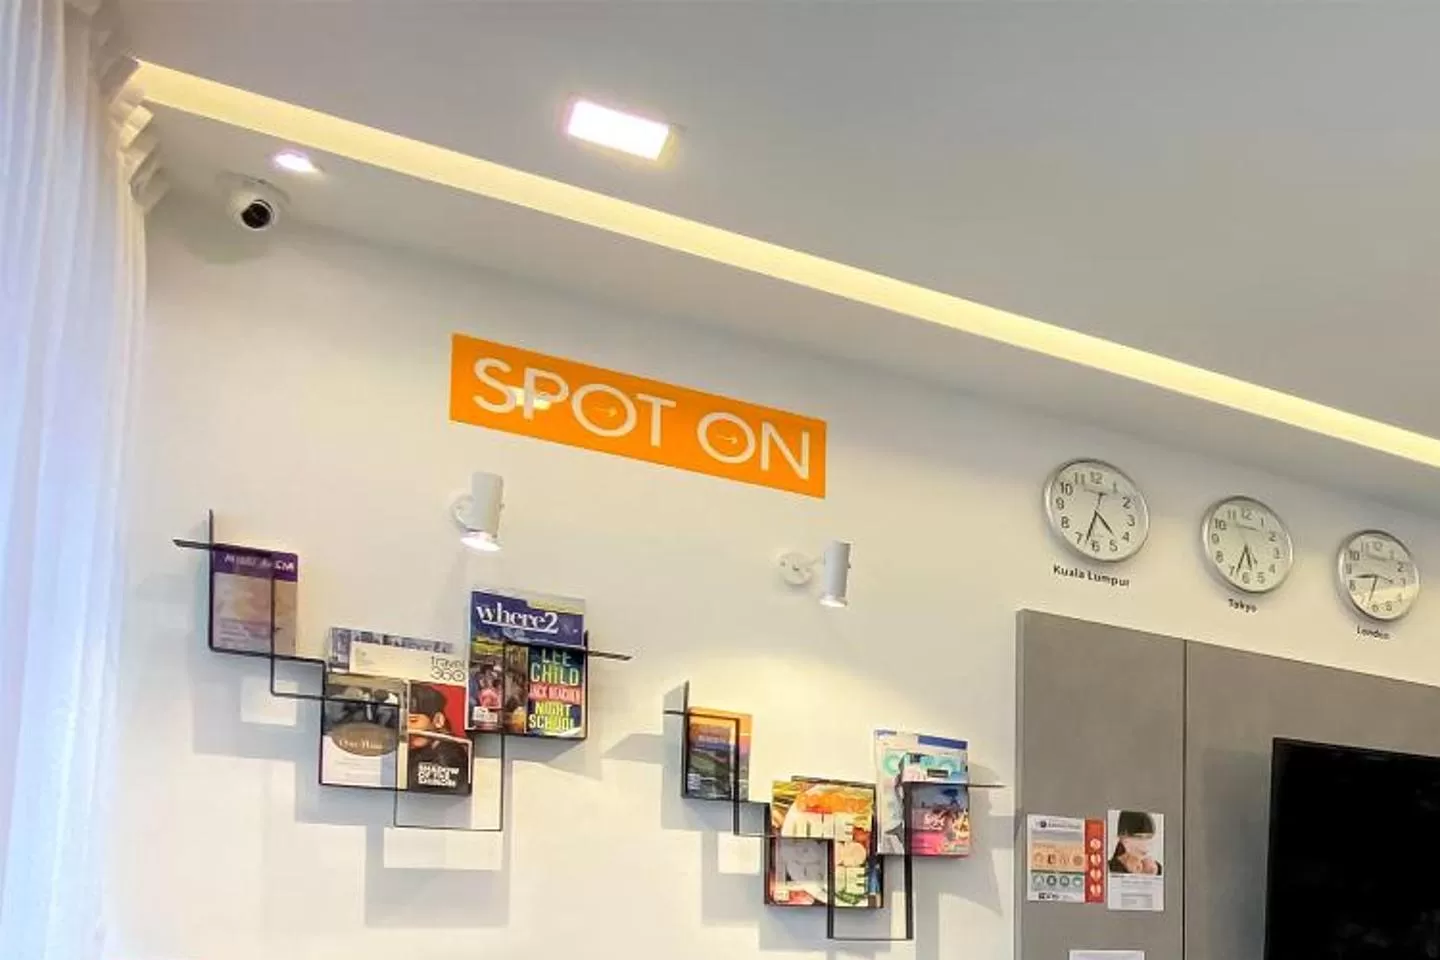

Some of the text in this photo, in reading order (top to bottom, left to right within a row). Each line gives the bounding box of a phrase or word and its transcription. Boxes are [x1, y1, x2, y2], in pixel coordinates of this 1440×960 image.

[472, 357, 810, 481] SPOT ON
[1053, 563, 1130, 587] Kuala Lumpur
[1228, 598, 1258, 613] Tokyo
[476, 602, 559, 634] where2
[541, 648, 573, 668] LEE
[530, 662, 580, 687] CHILD
